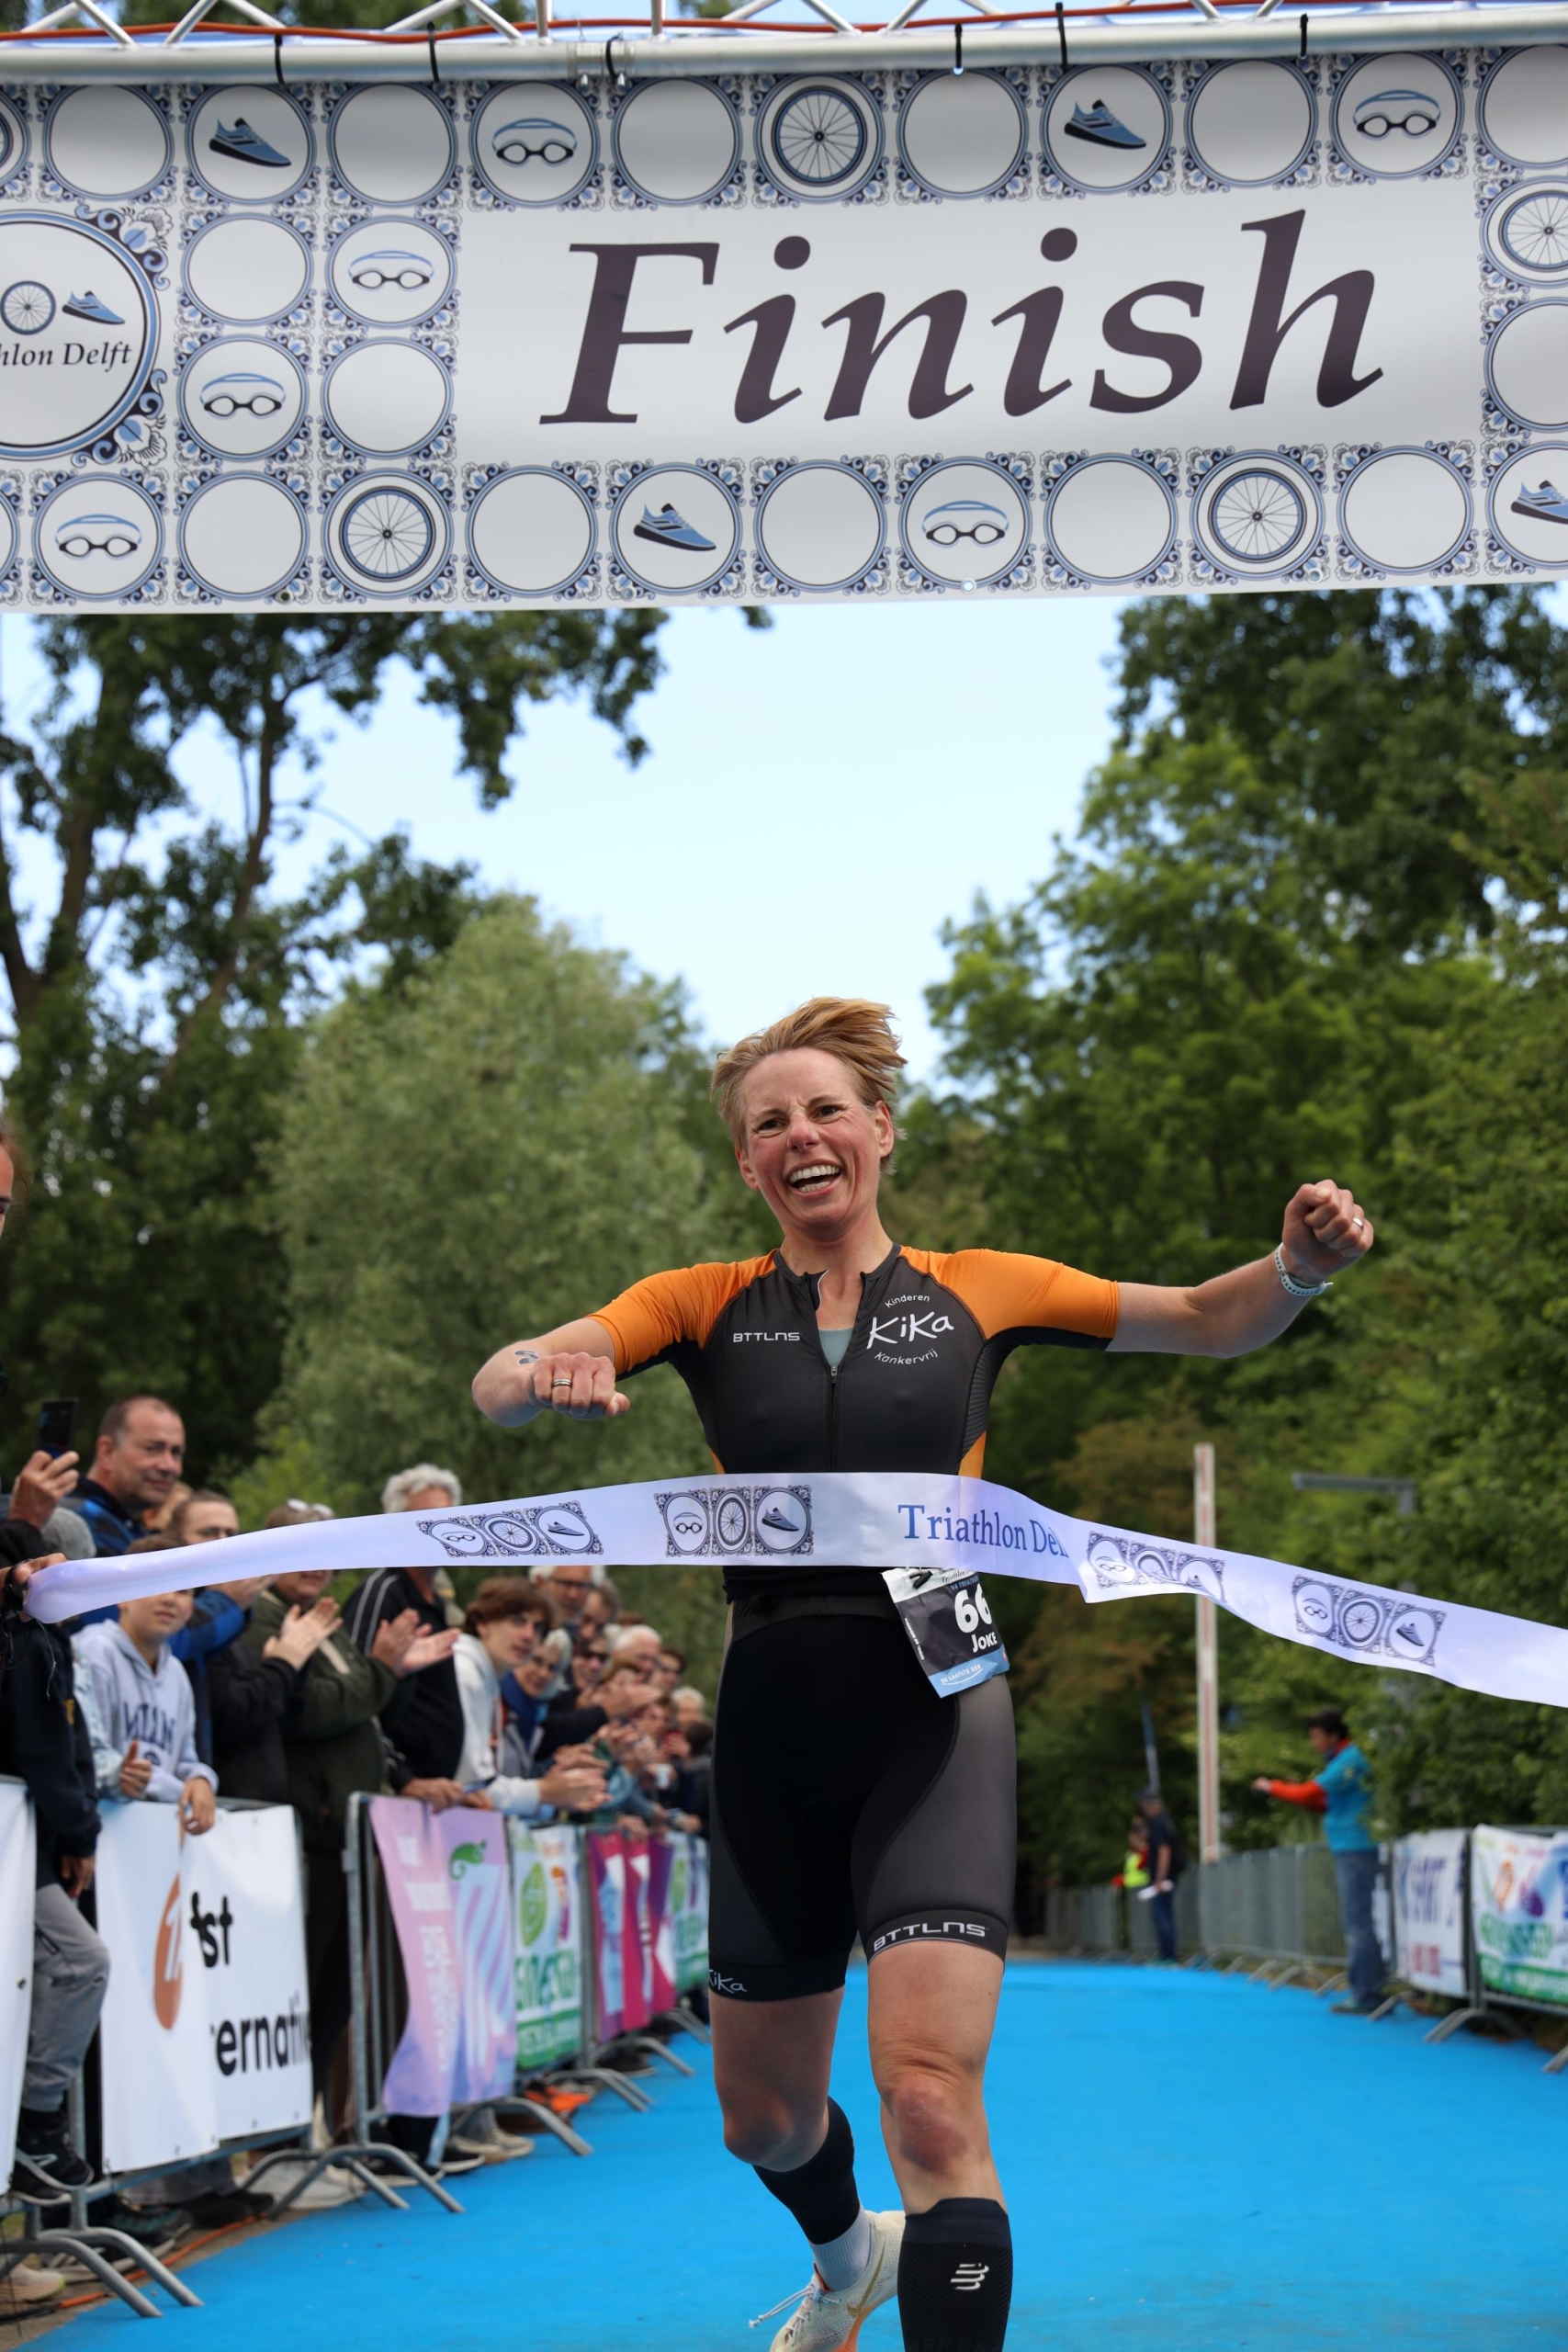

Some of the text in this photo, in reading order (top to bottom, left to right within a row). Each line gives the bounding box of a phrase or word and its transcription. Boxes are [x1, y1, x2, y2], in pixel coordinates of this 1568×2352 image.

[539, 209, 1383, 424] Finish
[62, 341, 132, 373] Delft
[885, 1294, 931, 1308] Kinderen
[733, 1332, 800, 1343] BTTLNS
[866, 1311, 954, 1350] KiKa
[874, 1348, 939, 1365] Kankervrij
[897, 1504, 1028, 1551] Triathlon
[970, 1631, 998, 1654] JOKE
[874, 1921, 986, 1952] BTTLNS
